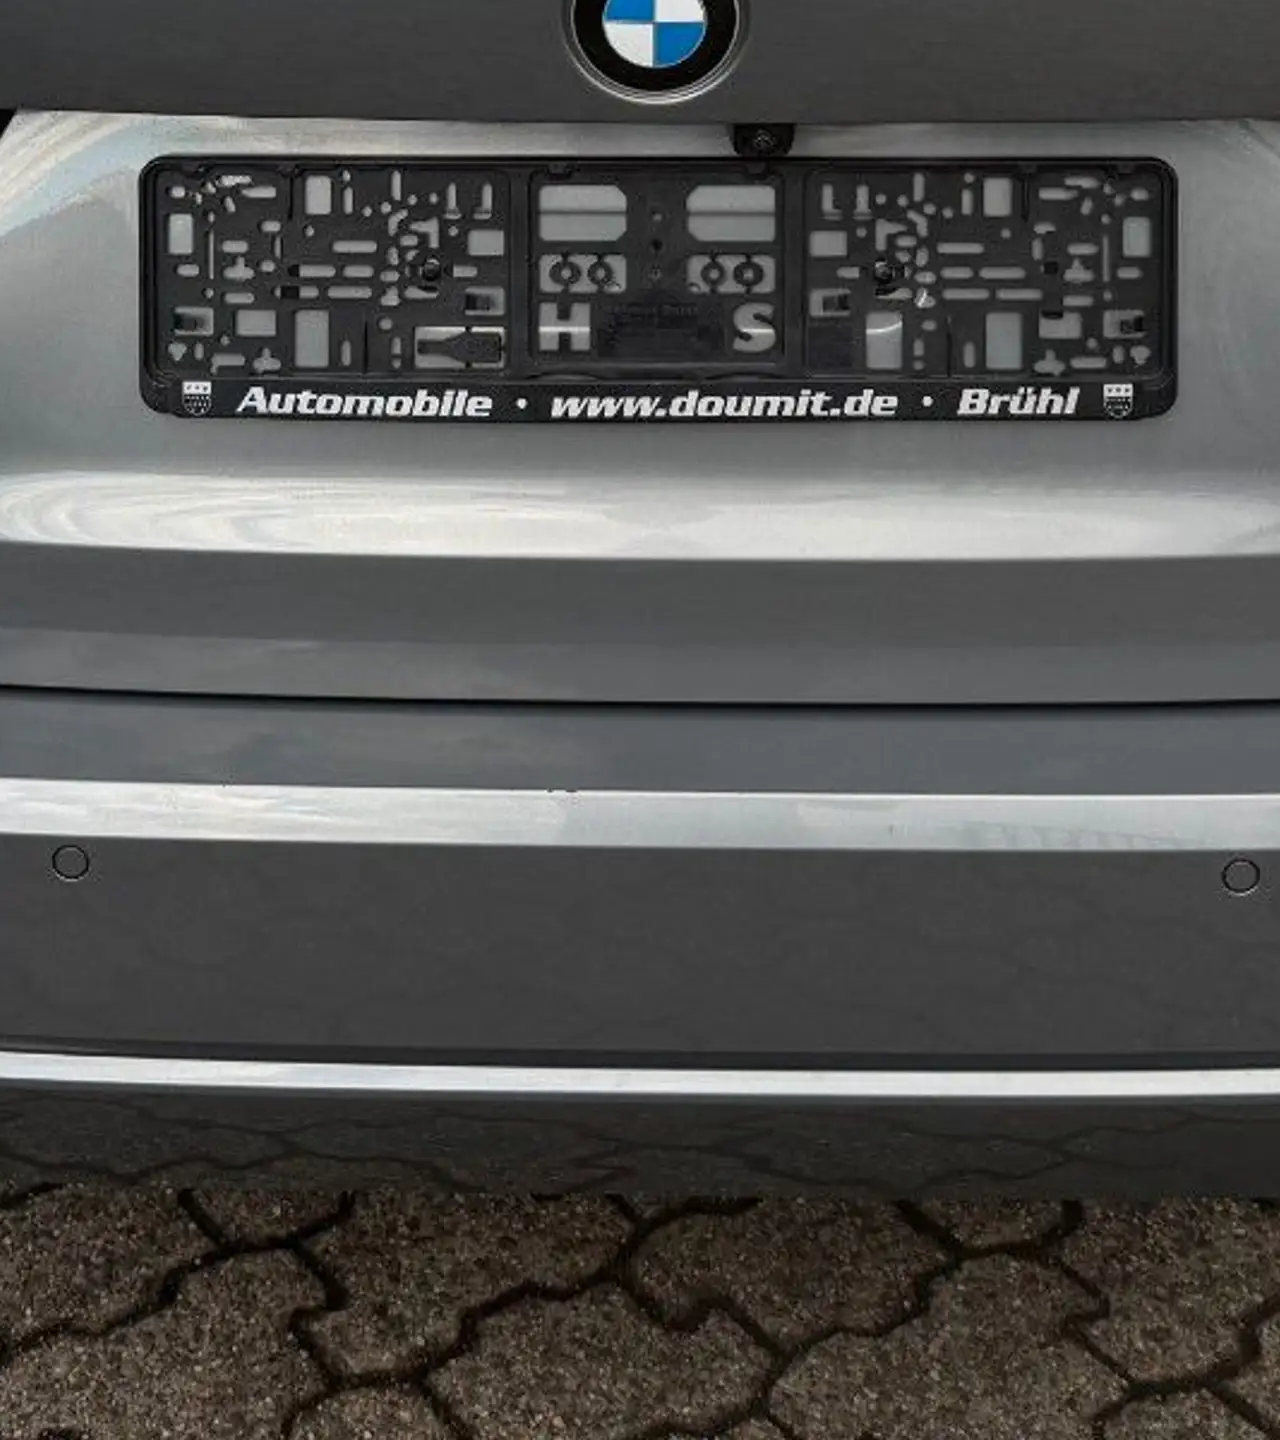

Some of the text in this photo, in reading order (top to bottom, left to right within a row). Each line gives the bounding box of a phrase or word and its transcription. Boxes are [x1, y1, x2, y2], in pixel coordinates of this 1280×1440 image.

[236, 386, 1080, 418] Automobile www.doumit.de Brühl
